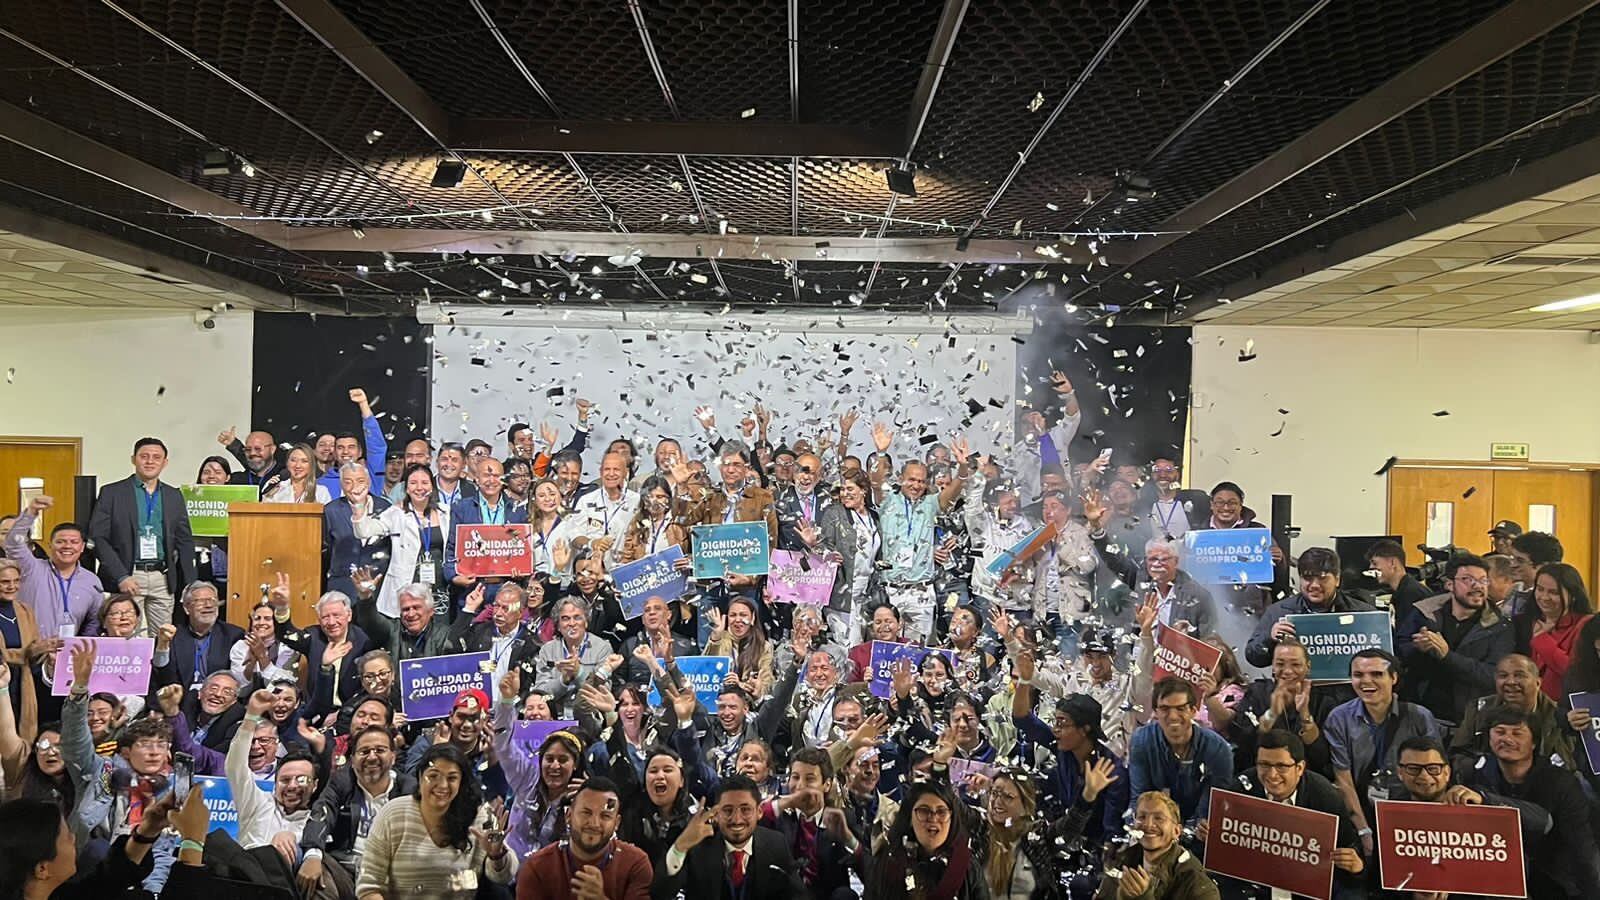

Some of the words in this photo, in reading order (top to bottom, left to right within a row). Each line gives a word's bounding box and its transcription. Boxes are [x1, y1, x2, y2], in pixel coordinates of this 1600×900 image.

[187, 509, 229, 518] COMPRO
[1196, 554, 1263, 563] COMPROSO
[1300, 633, 1367, 645] DIGNIDAD
[1370, 633, 1382, 645] &
[132, 655, 143, 665] &
[66, 665, 142, 674] CPROMISO
[474, 672, 483, 682] &
[1222, 817, 1303, 848] DIGNIDAD
[1307, 838, 1320, 853] &
[1394, 828, 1487, 847] DIGNIDAD
[1491, 833, 1506, 848] &
[1220, 831, 1320, 865] COMPROMISO
[1395, 844, 1508, 862] COMPROMISO
